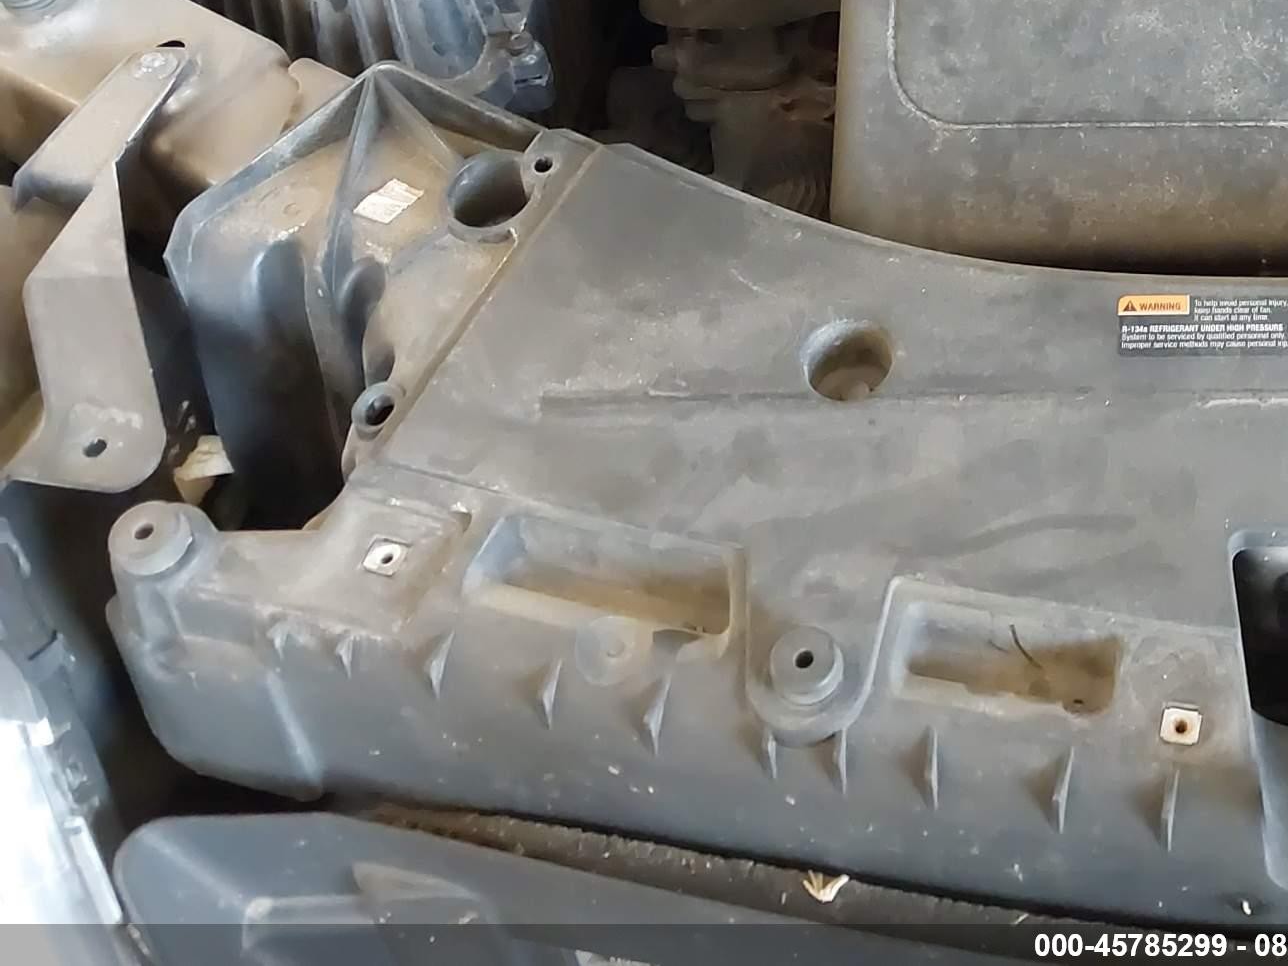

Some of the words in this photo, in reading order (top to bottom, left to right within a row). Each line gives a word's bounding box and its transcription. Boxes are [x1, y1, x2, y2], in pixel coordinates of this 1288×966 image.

[1139, 302, 1181, 312] WARNING
[1203, 299, 1218, 308] help
[1219, 299, 1238, 307] avoid
[1239, 299, 1268, 308] personal
[1268, 299, 1288, 308] injury.
[1194, 307, 1211, 315] keep
[1214, 314, 1230, 322] start
[1239, 315, 1251, 323] any
[1122, 325, 1148, 333] R-134a
[1149, 324, 1199, 333] REFRIGERANT
[1200, 324, 1225, 333] UNDER
[1226, 324, 1244, 332] HIGH
[1246, 324, 1284, 332] PRESSURE
[1121, 333, 1147, 342] System
[1167, 332, 1195, 340] serviced
[1196, 332, 1205, 341] by
[1206, 332, 1236, 341] qualified
[1236, 332, 1269, 341] personnel
[1121, 341, 1152, 350] Improper
[1247, 340, 1276, 349] personal
